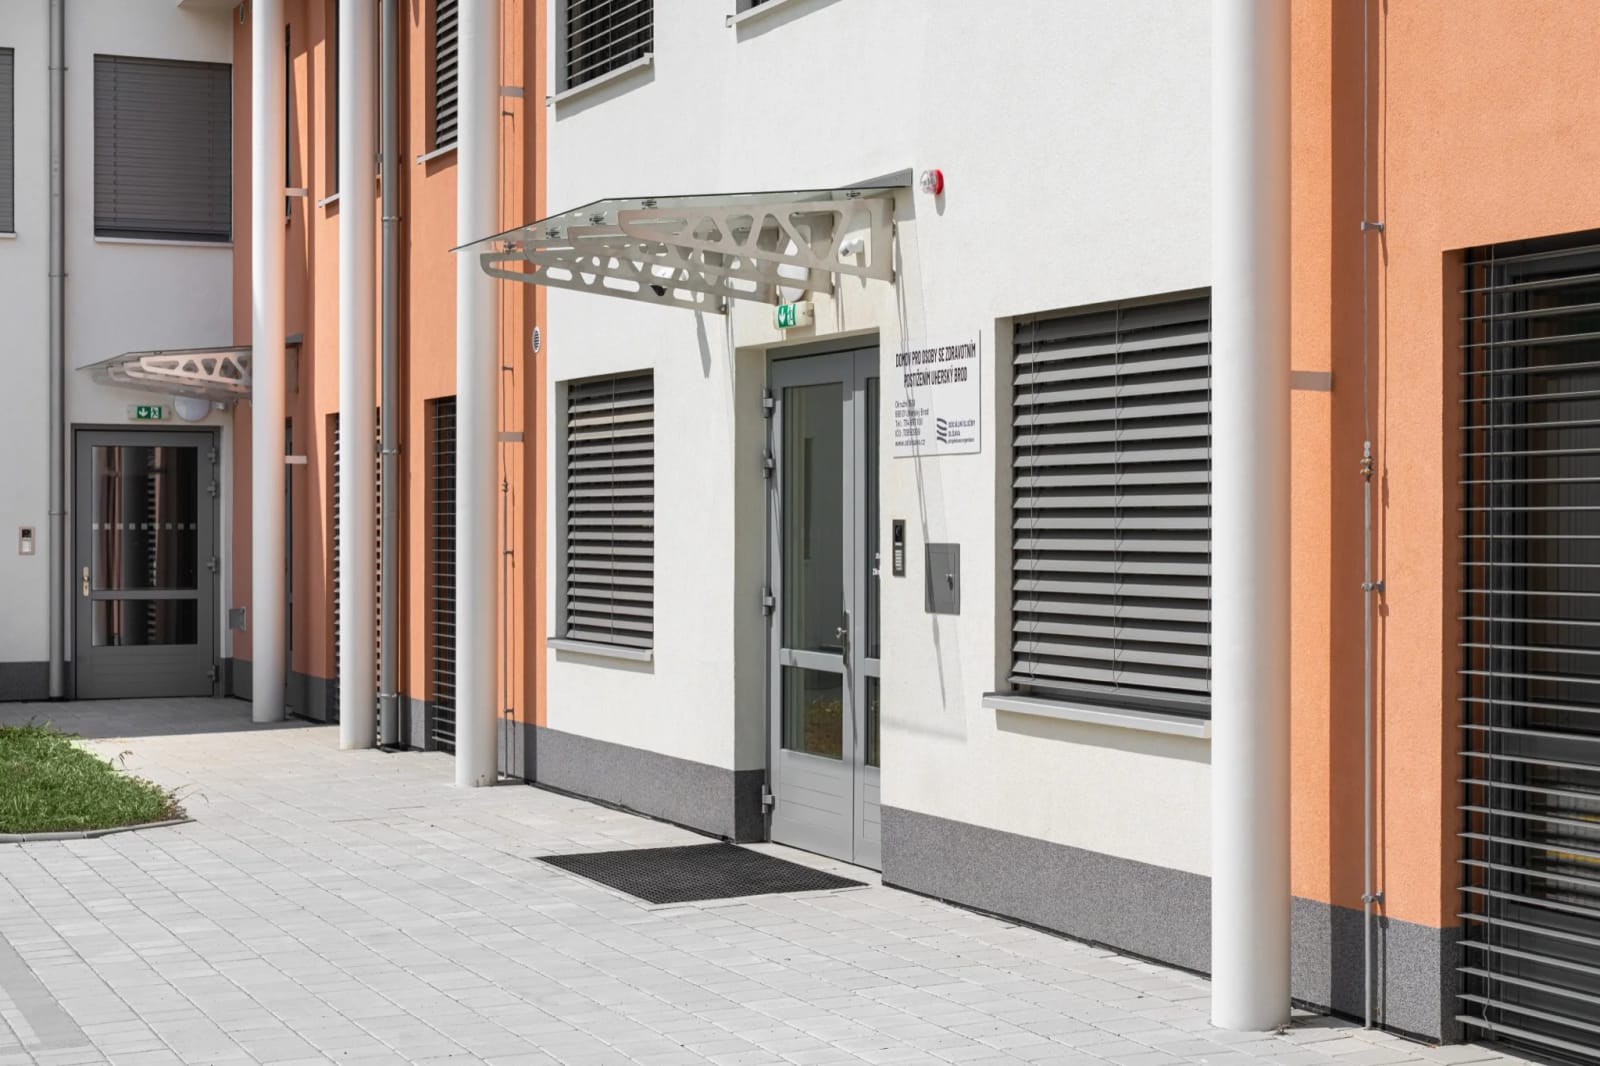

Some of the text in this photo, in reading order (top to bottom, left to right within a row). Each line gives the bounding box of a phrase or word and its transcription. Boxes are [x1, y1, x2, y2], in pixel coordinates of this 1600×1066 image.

[896, 339, 976, 368] DOMOV PRO OSOBY SE ZDRAVOTNÍM
[904, 365, 967, 388] POSTIŽENÍM UHERSKÝ BROD
